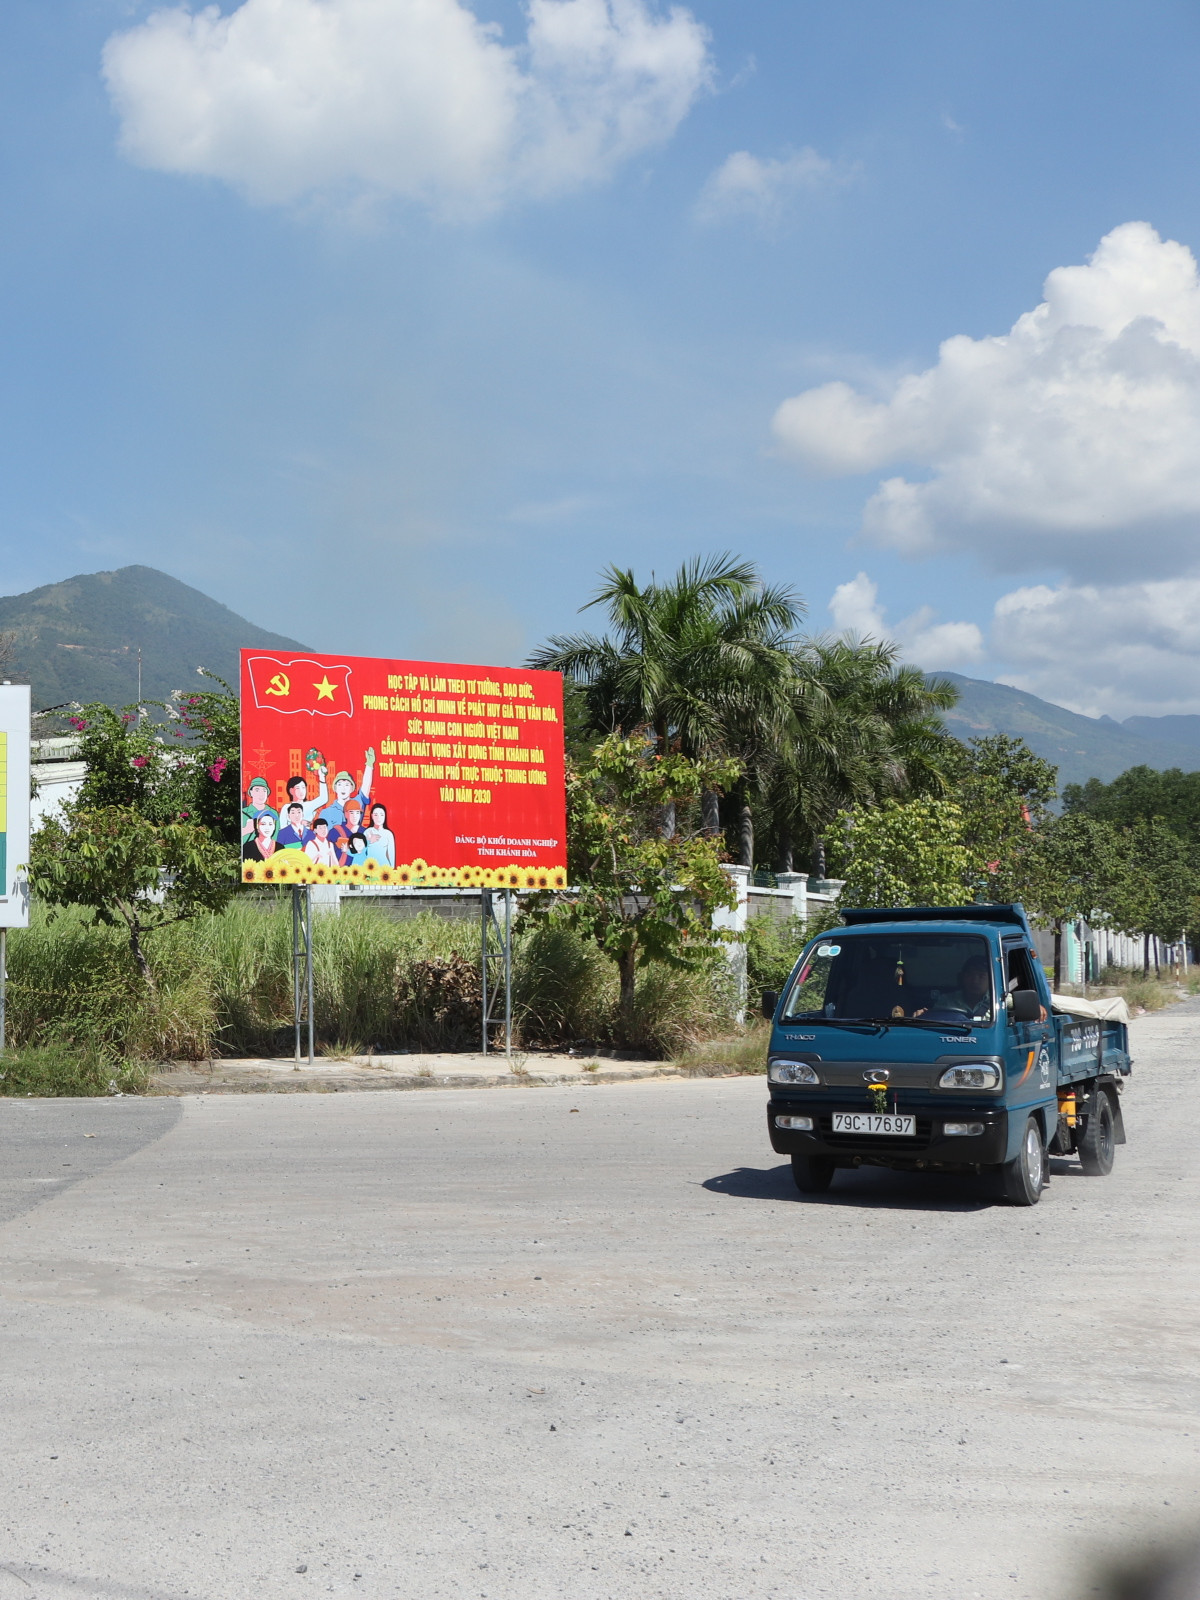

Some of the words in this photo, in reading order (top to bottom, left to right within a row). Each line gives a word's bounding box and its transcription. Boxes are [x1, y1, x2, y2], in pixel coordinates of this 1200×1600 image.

[388, 674, 403, 691] HỌC
[404, 673, 418, 693] TẬP
[420, 674, 430, 691] VÀ
[430, 675, 446, 692] LÀM
[448, 678, 465, 694] THEO
[468, 679, 477, 694] TƯ
[477, 677, 502, 698] TƯỞNG,
[504, 681, 517, 700] ĐẠO
[519, 681, 535, 700] ĐỨC,
[363, 695, 388, 711] PHONG
[390, 692, 409, 712] CÁCH
[423, 696, 435, 714] CHÍ
[436, 699, 456, 714] MINH
[468, 700, 485, 717] PHÁT
[488, 703, 500, 718] HUY
[502, 702, 514, 719] GIÁ
[515, 704, 526, 722] TRỊ
[528, 704, 541, 721] VĂN
[543, 705, 558, 723] HÓA,
[408, 717, 422, 735] SỨC
[424, 720, 445, 738] MẠNH
[447, 722, 462, 737] CON
[464, 721, 486, 738] NGƯỜI
[487, 722, 501, 742] VIỆT
[503, 726, 519, 740] NAM
[381, 736, 396, 755] GẮN
[398, 739, 410, 756] VỚI
[412, 740, 430, 757] KHÁT
[432, 743, 451, 760] VỌNG
[453, 742, 466, 759] XÂY
[468, 745, 487, 762] DỰNG
[489, 742, 504, 761] TỈNH
[506, 745, 529, 763] KHÁNH
[531, 746, 544, 763] HÒA
[379, 758, 393, 777] TRỞ
[395, 762, 418, 778] THÀNH
[420, 762, 444, 780] THÀNH
[461, 766, 479, 784] TRỰC
[481, 765, 503, 785] THUỘC
[505, 769, 526, 784] TRUNG
[528, 769, 547, 785] ƯƠNG
[440, 785, 454, 802] VÀO
[455, 786, 472, 802] NĂM
[474, 789, 491, 804] 2030
[835, 1114, 912, 1133] 79C-176.97
